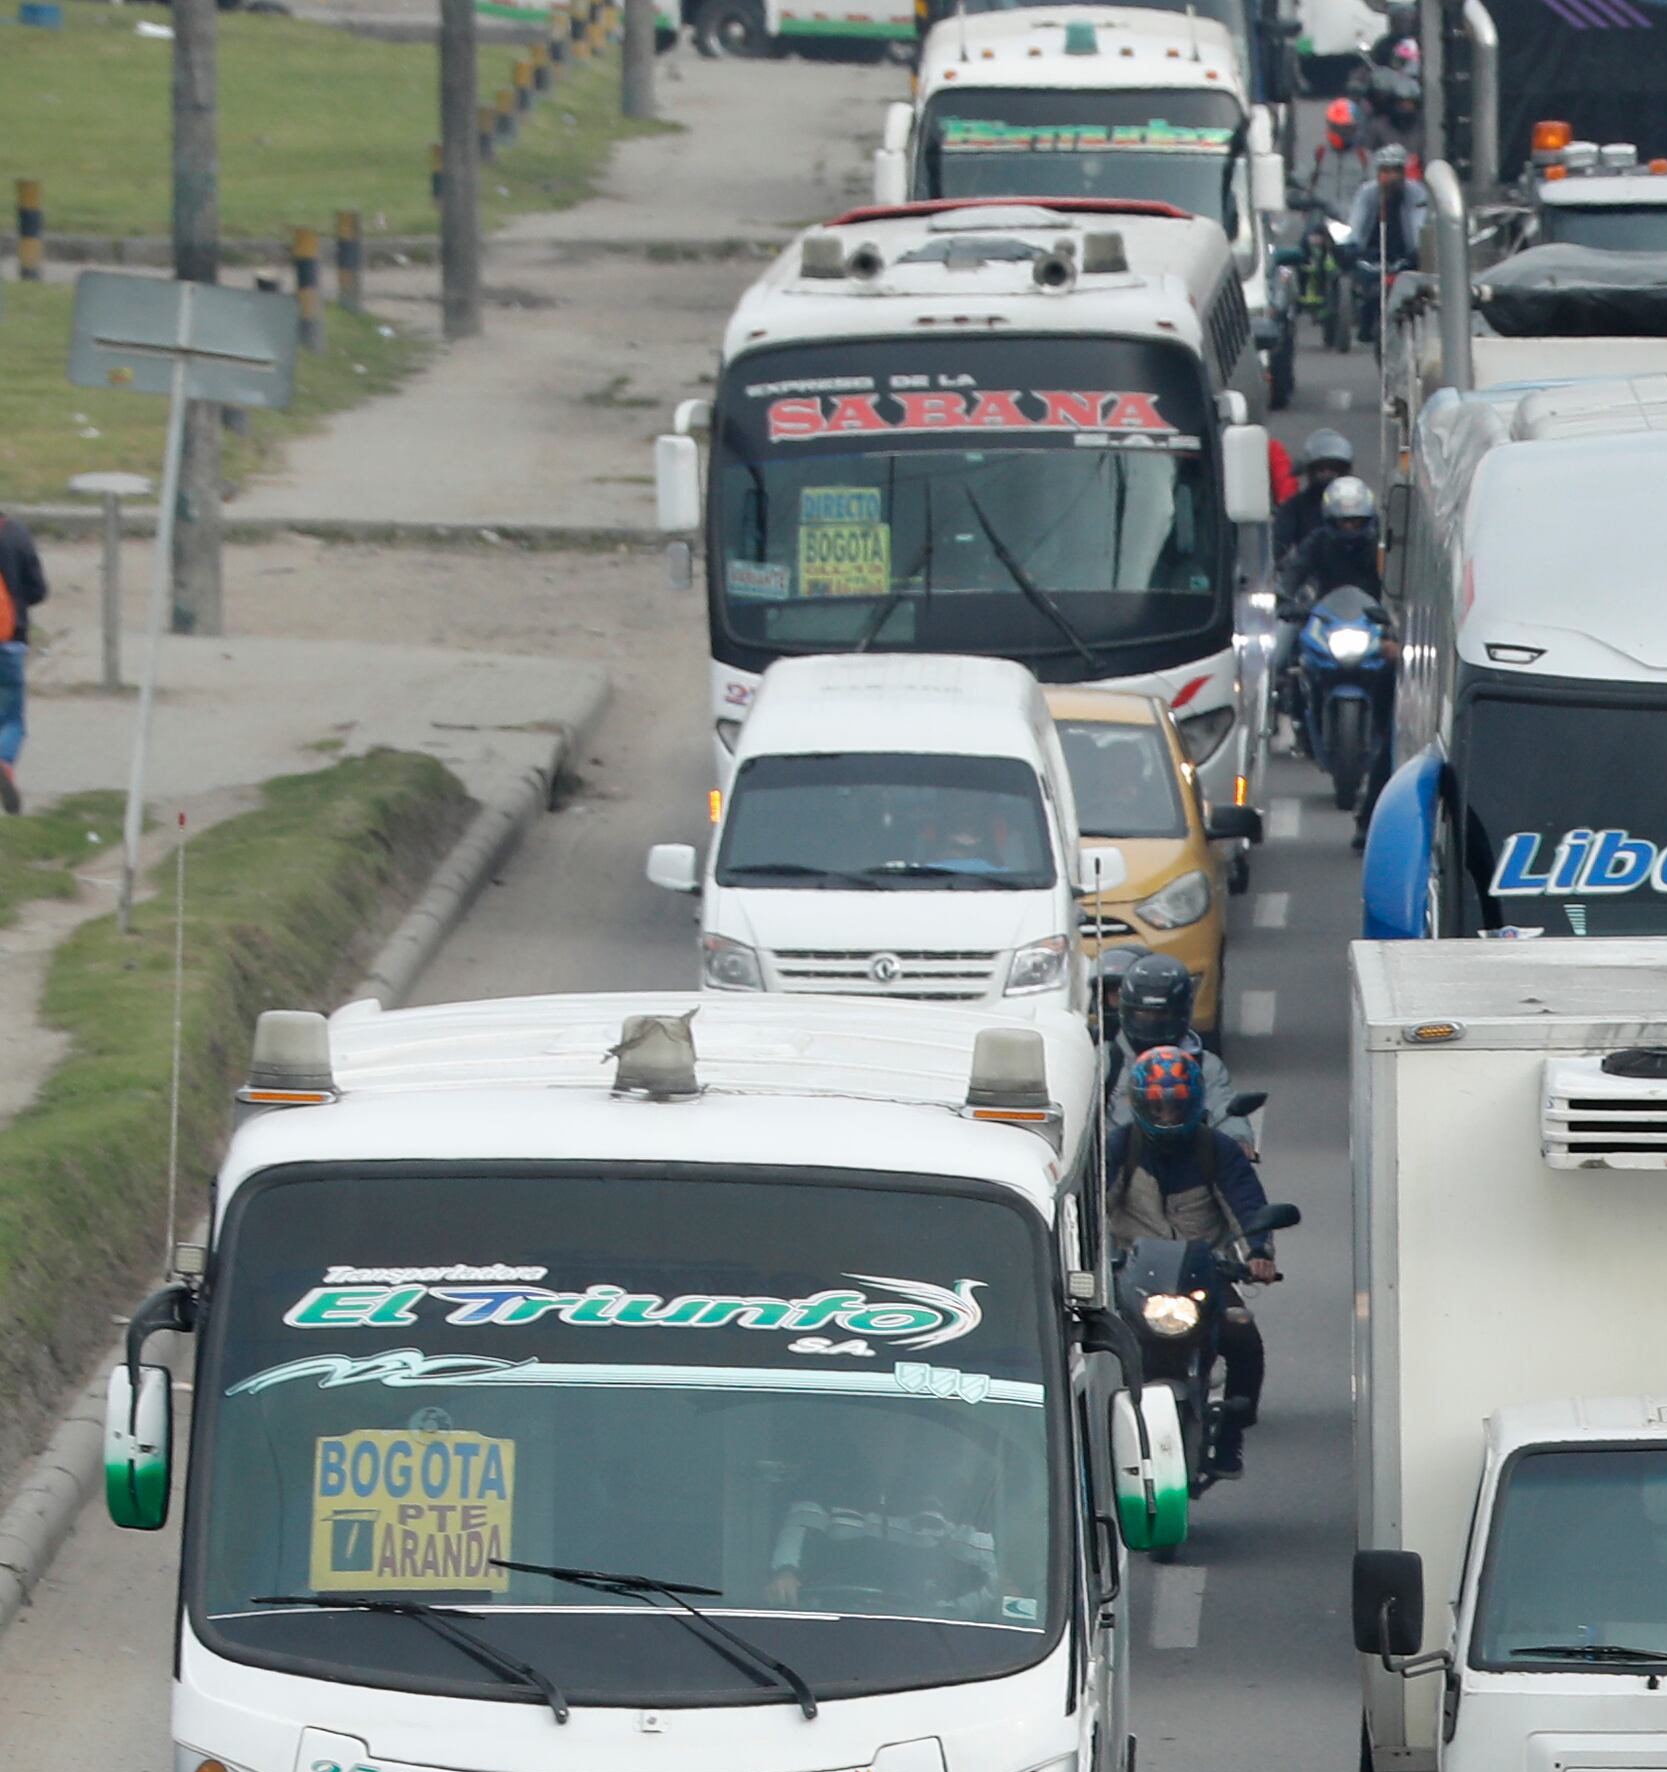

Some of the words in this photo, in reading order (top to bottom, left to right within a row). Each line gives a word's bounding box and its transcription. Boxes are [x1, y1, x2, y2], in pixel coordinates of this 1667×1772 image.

[889, 375, 930, 388] DE
[938, 374, 977, 387] LA
[767, 390, 1180, 443] SABANA
[802, 492, 881, 519] DIRECTO
[804, 531, 884, 565] BOGOTA
[283, 1285, 420, 1330] El
[421, 1284, 946, 1334] Triunfo
[319, 1439, 507, 1501] BOGOTA
[397, 1504, 489, 1533] PTE
[377, 1523, 505, 1579] ARANDA
